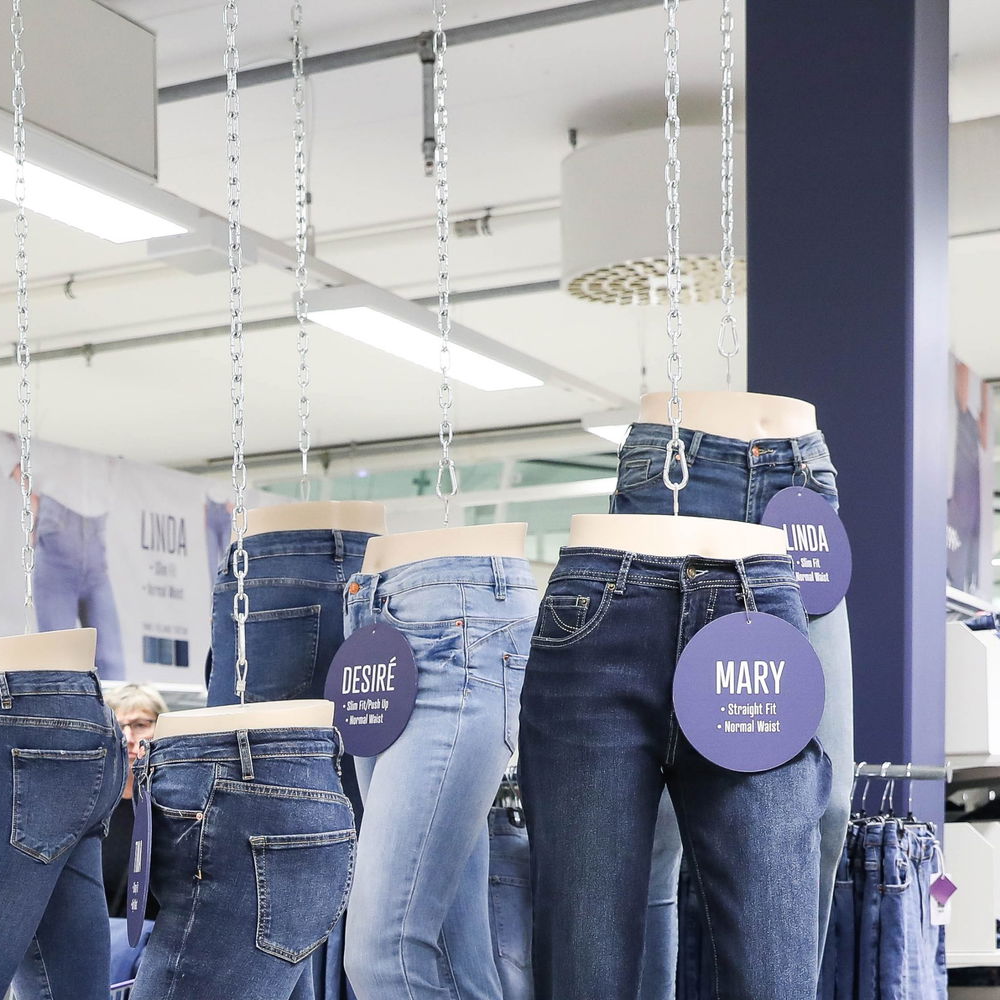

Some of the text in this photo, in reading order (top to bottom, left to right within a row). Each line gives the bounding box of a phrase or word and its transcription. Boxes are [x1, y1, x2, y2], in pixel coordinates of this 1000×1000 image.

[141, 509, 188, 556] LINDA
[783, 523, 830, 552] LINDA
[342, 656, 397, 694] DESIRÉ
[716, 660, 786, 695] MARY
[346, 700, 359, 712] Slim
[381, 698, 389, 711] Up
[728, 702, 777, 718] Straight Fit
[349, 713, 369, 725] Normal
[724, 719, 781, 733] Normal Waist
